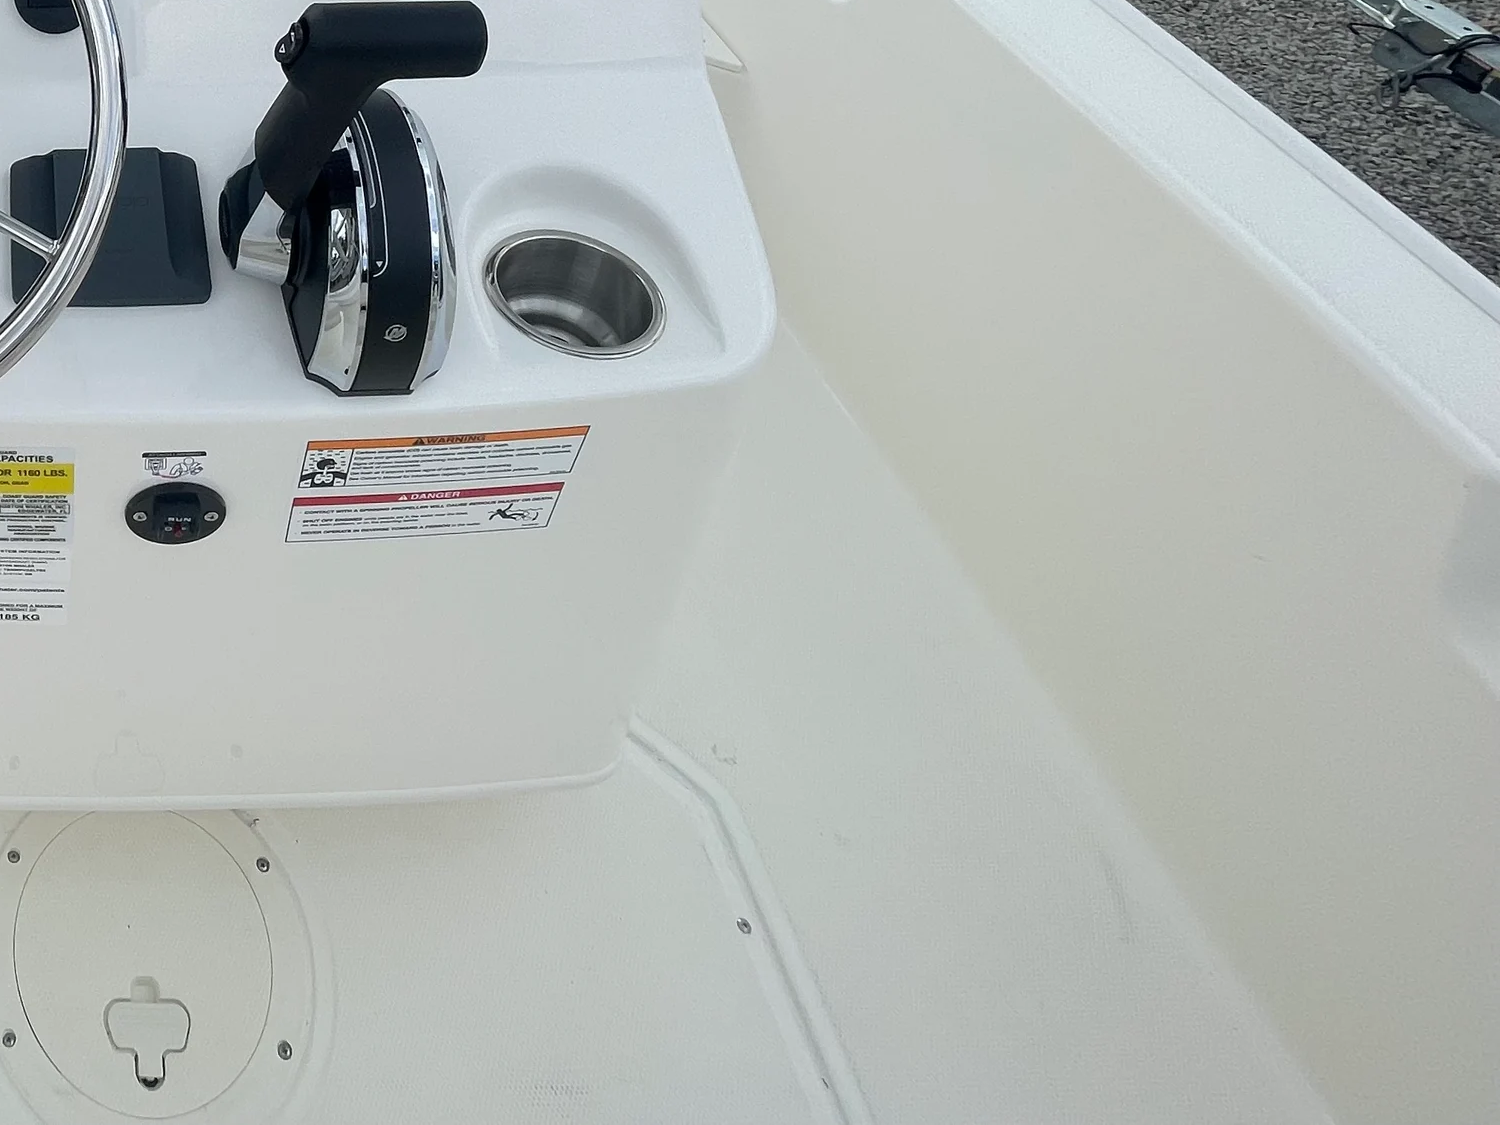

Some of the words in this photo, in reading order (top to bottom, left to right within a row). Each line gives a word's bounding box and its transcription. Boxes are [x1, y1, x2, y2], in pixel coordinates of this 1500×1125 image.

[426, 434, 486, 446] WARNING
[17, 469, 41, 477] 1160
[43, 469, 68, 477] LBS.
[410, 490, 461, 501] DANGER
